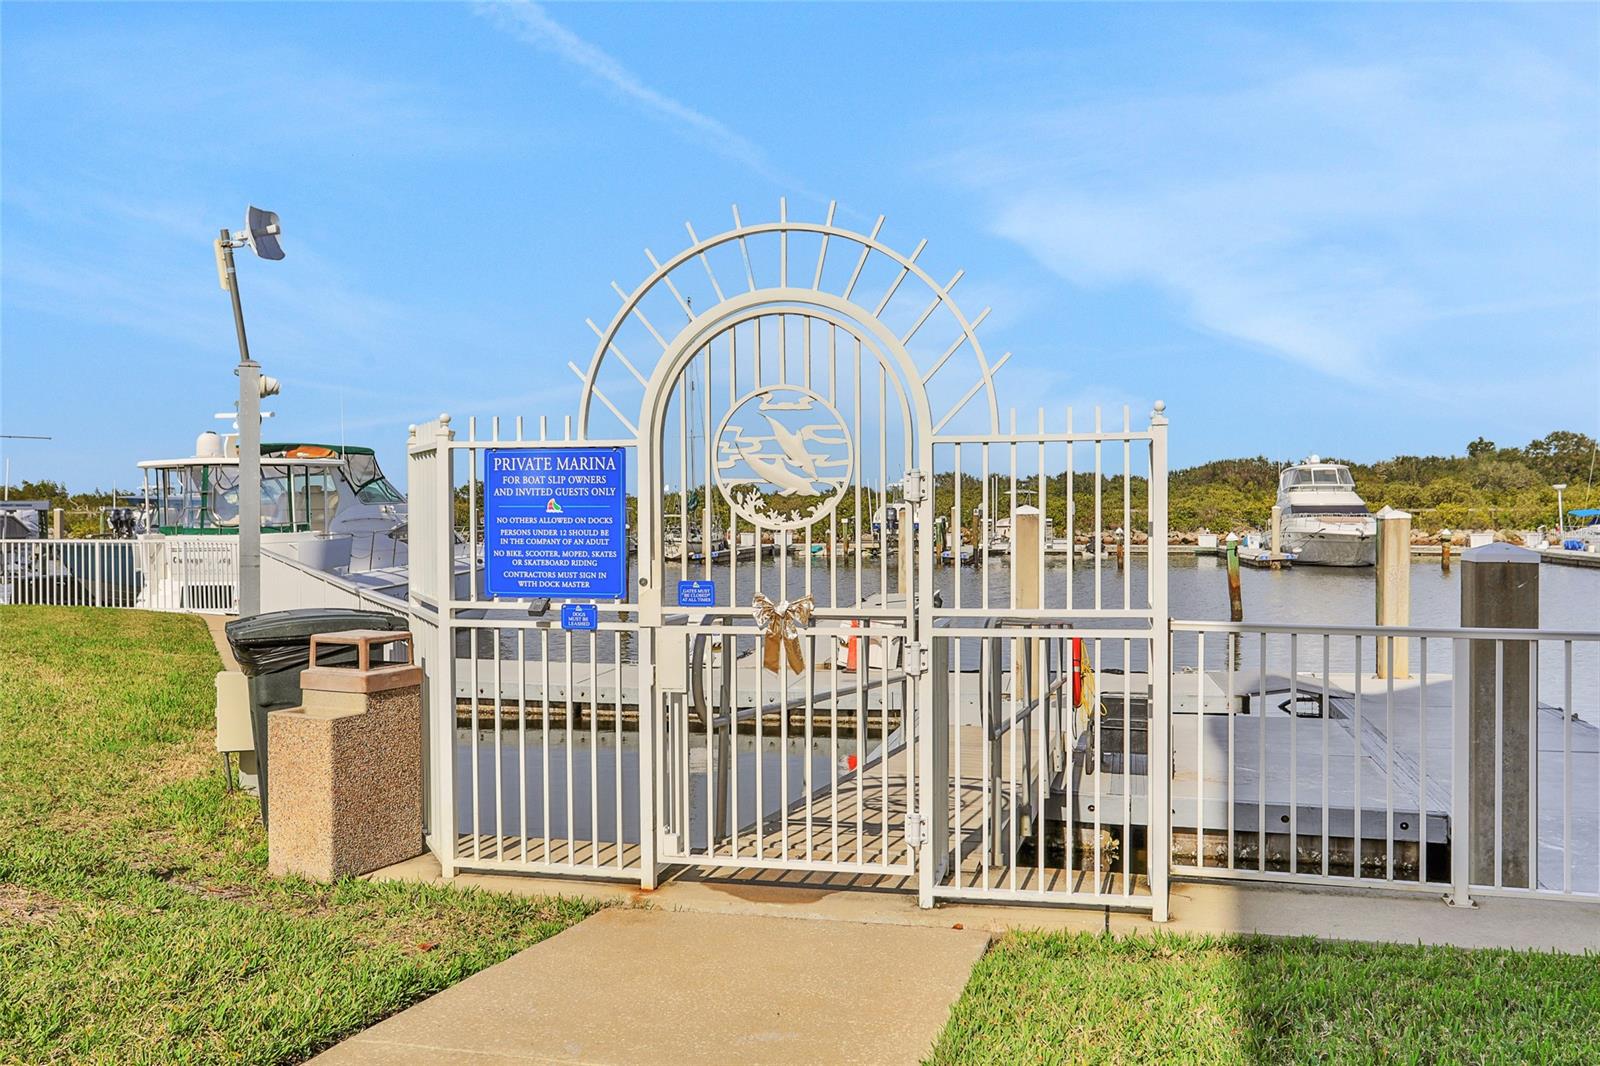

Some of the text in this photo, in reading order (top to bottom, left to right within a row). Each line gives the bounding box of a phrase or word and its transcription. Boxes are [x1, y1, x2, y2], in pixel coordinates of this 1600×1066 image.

[494, 457, 616, 470] PRIVATE MARINA
[502, 476, 606, 484] FOR BOAT SLIP OWNERS
[494, 488, 616, 496] AND INVITED GUESTS ONLY
